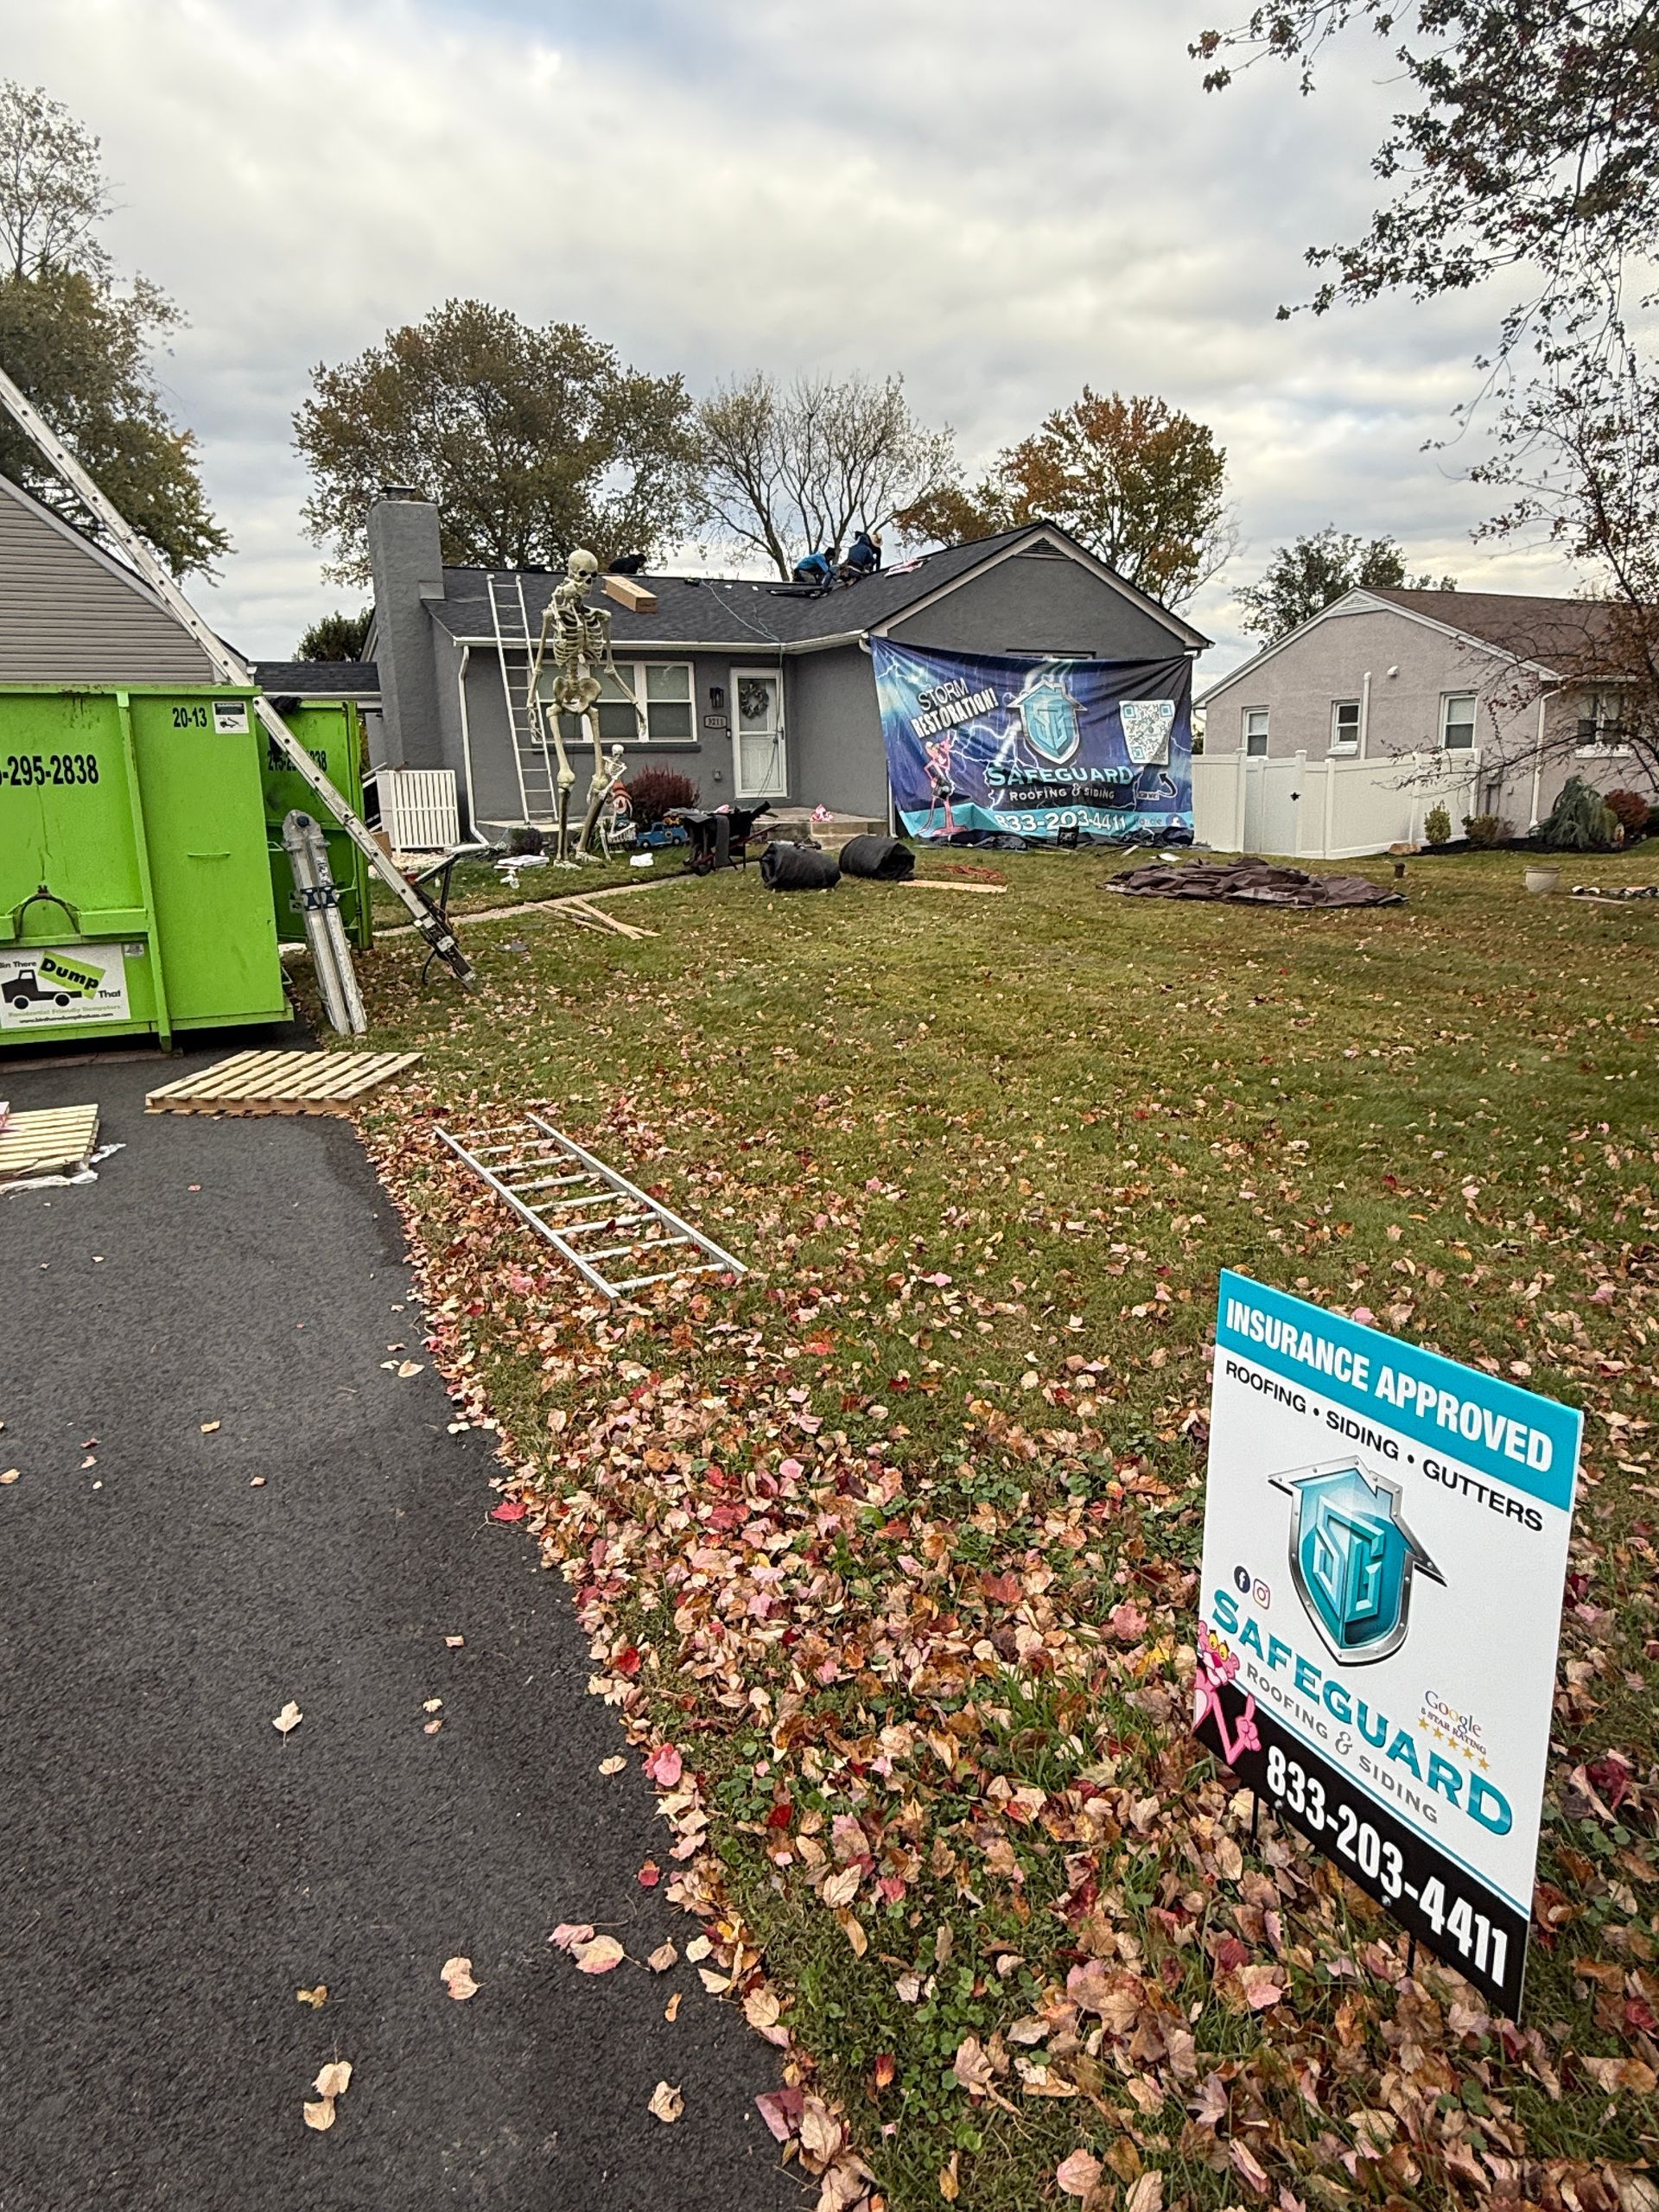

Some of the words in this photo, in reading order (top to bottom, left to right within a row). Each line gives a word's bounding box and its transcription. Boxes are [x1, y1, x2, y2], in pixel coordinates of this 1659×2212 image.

[910, 687, 999, 739] RESTORATION!
[918, 677, 969, 711] STORM
[172, 707, 207, 728] 20-13
[0, 754, 99, 786] -295-2838
[987, 766, 1134, 787] SAFEGUARD
[1009, 787, 1067, 802] ROOFING
[1071, 783, 1081, 797] &
[1084, 787, 1115, 800] SIDING
[994, 810, 1127, 832] 833-203-4411
[41, 957, 99, 990] Dump
[98, 989, 121, 999] That
[1225, 1298, 1370, 1393] INSURANCE
[1374, 1366, 1553, 1472] APPROVED
[1225, 1360, 1306, 1414] ROOFING
[1325, 1411, 1399, 1461] SIDING
[1422, 1458, 1543, 1532] GUTTERS
[1211, 1589, 1513, 1835] SAFEGUARD
[1425, 1690, 1482, 1738] Google
[1246, 1662, 1328, 1740] ROOFING
[1335, 1732, 1354, 1756] &
[1359, 1755, 1438, 1824] SIDING
[1427, 1711, 1451, 1732] STAR
[1452, 1726, 1487, 1756] RATING
[1265, 1745, 1509, 1987] 833-203-4411
